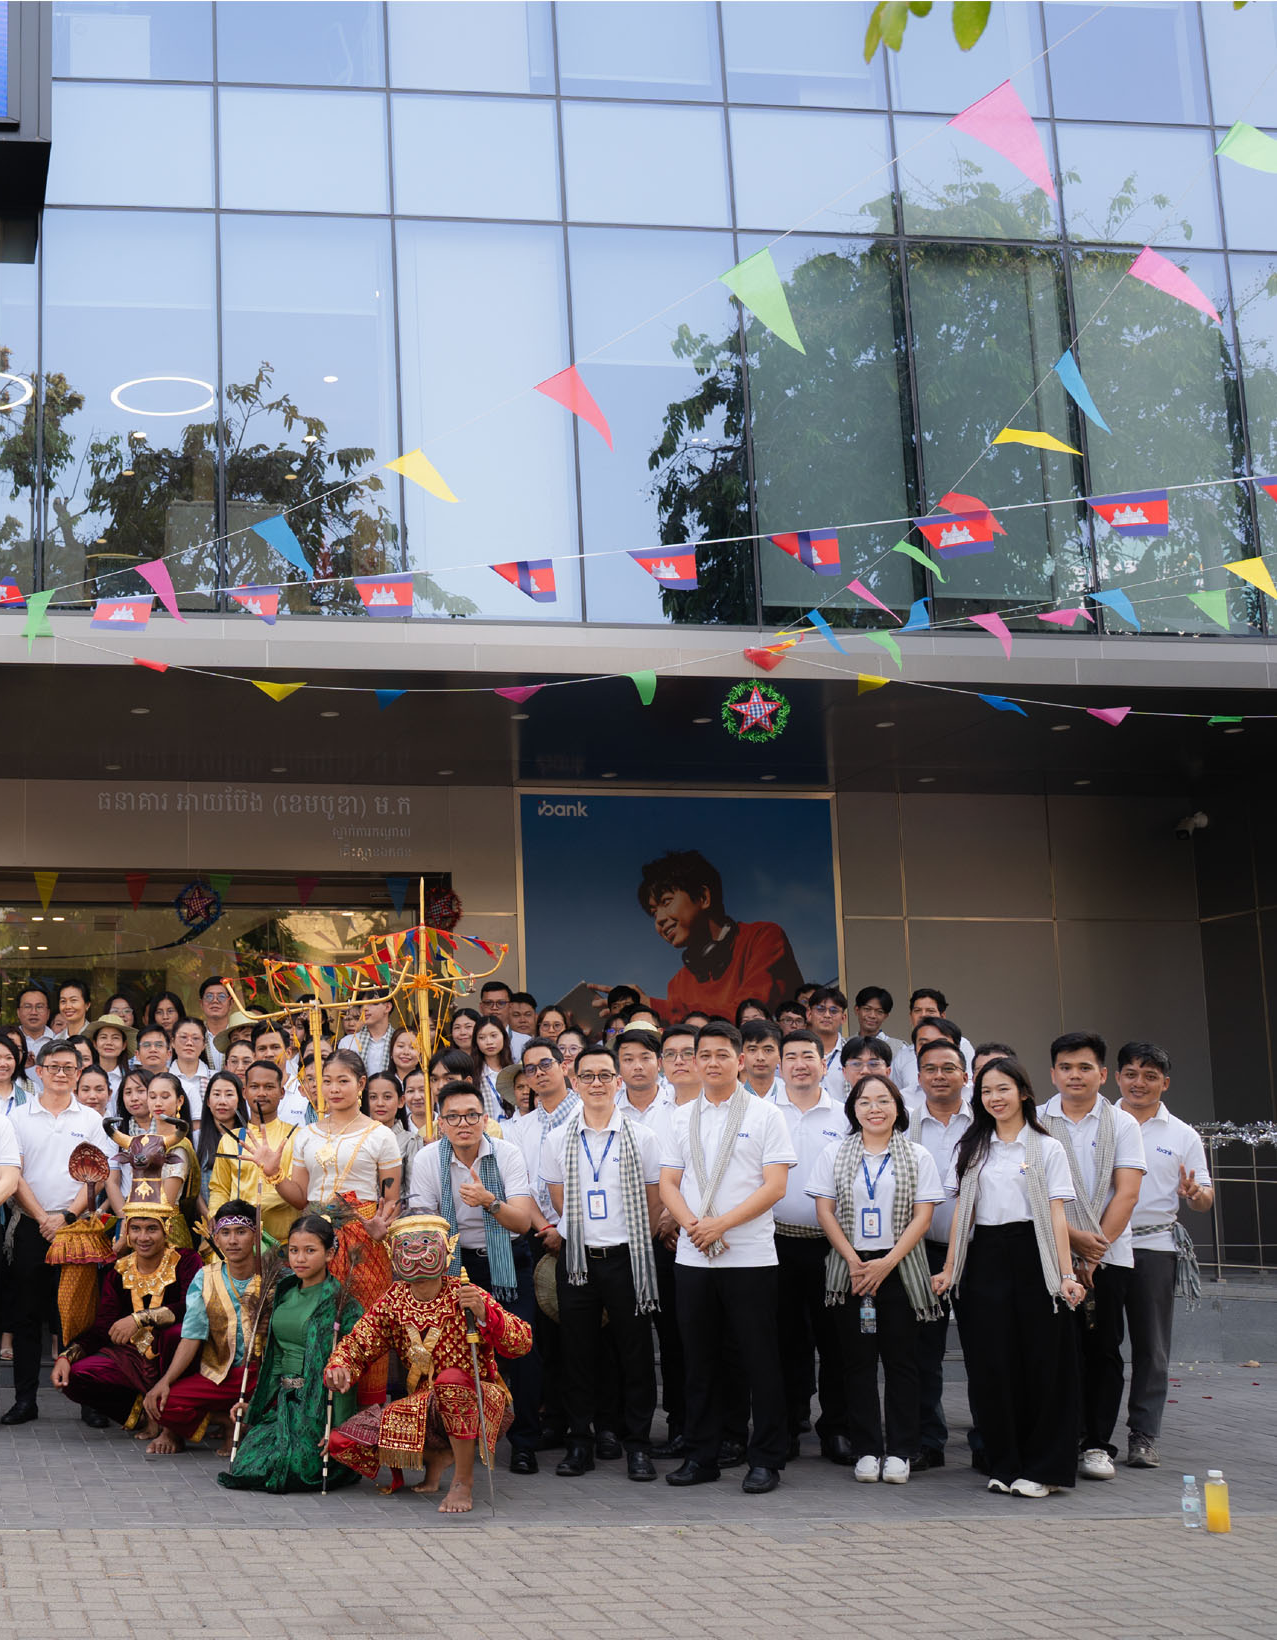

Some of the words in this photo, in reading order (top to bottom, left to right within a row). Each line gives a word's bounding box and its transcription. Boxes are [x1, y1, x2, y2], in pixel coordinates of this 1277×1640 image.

[97, 791, 168, 811] ធនាគារ
[537, 800, 588, 817] ibank
